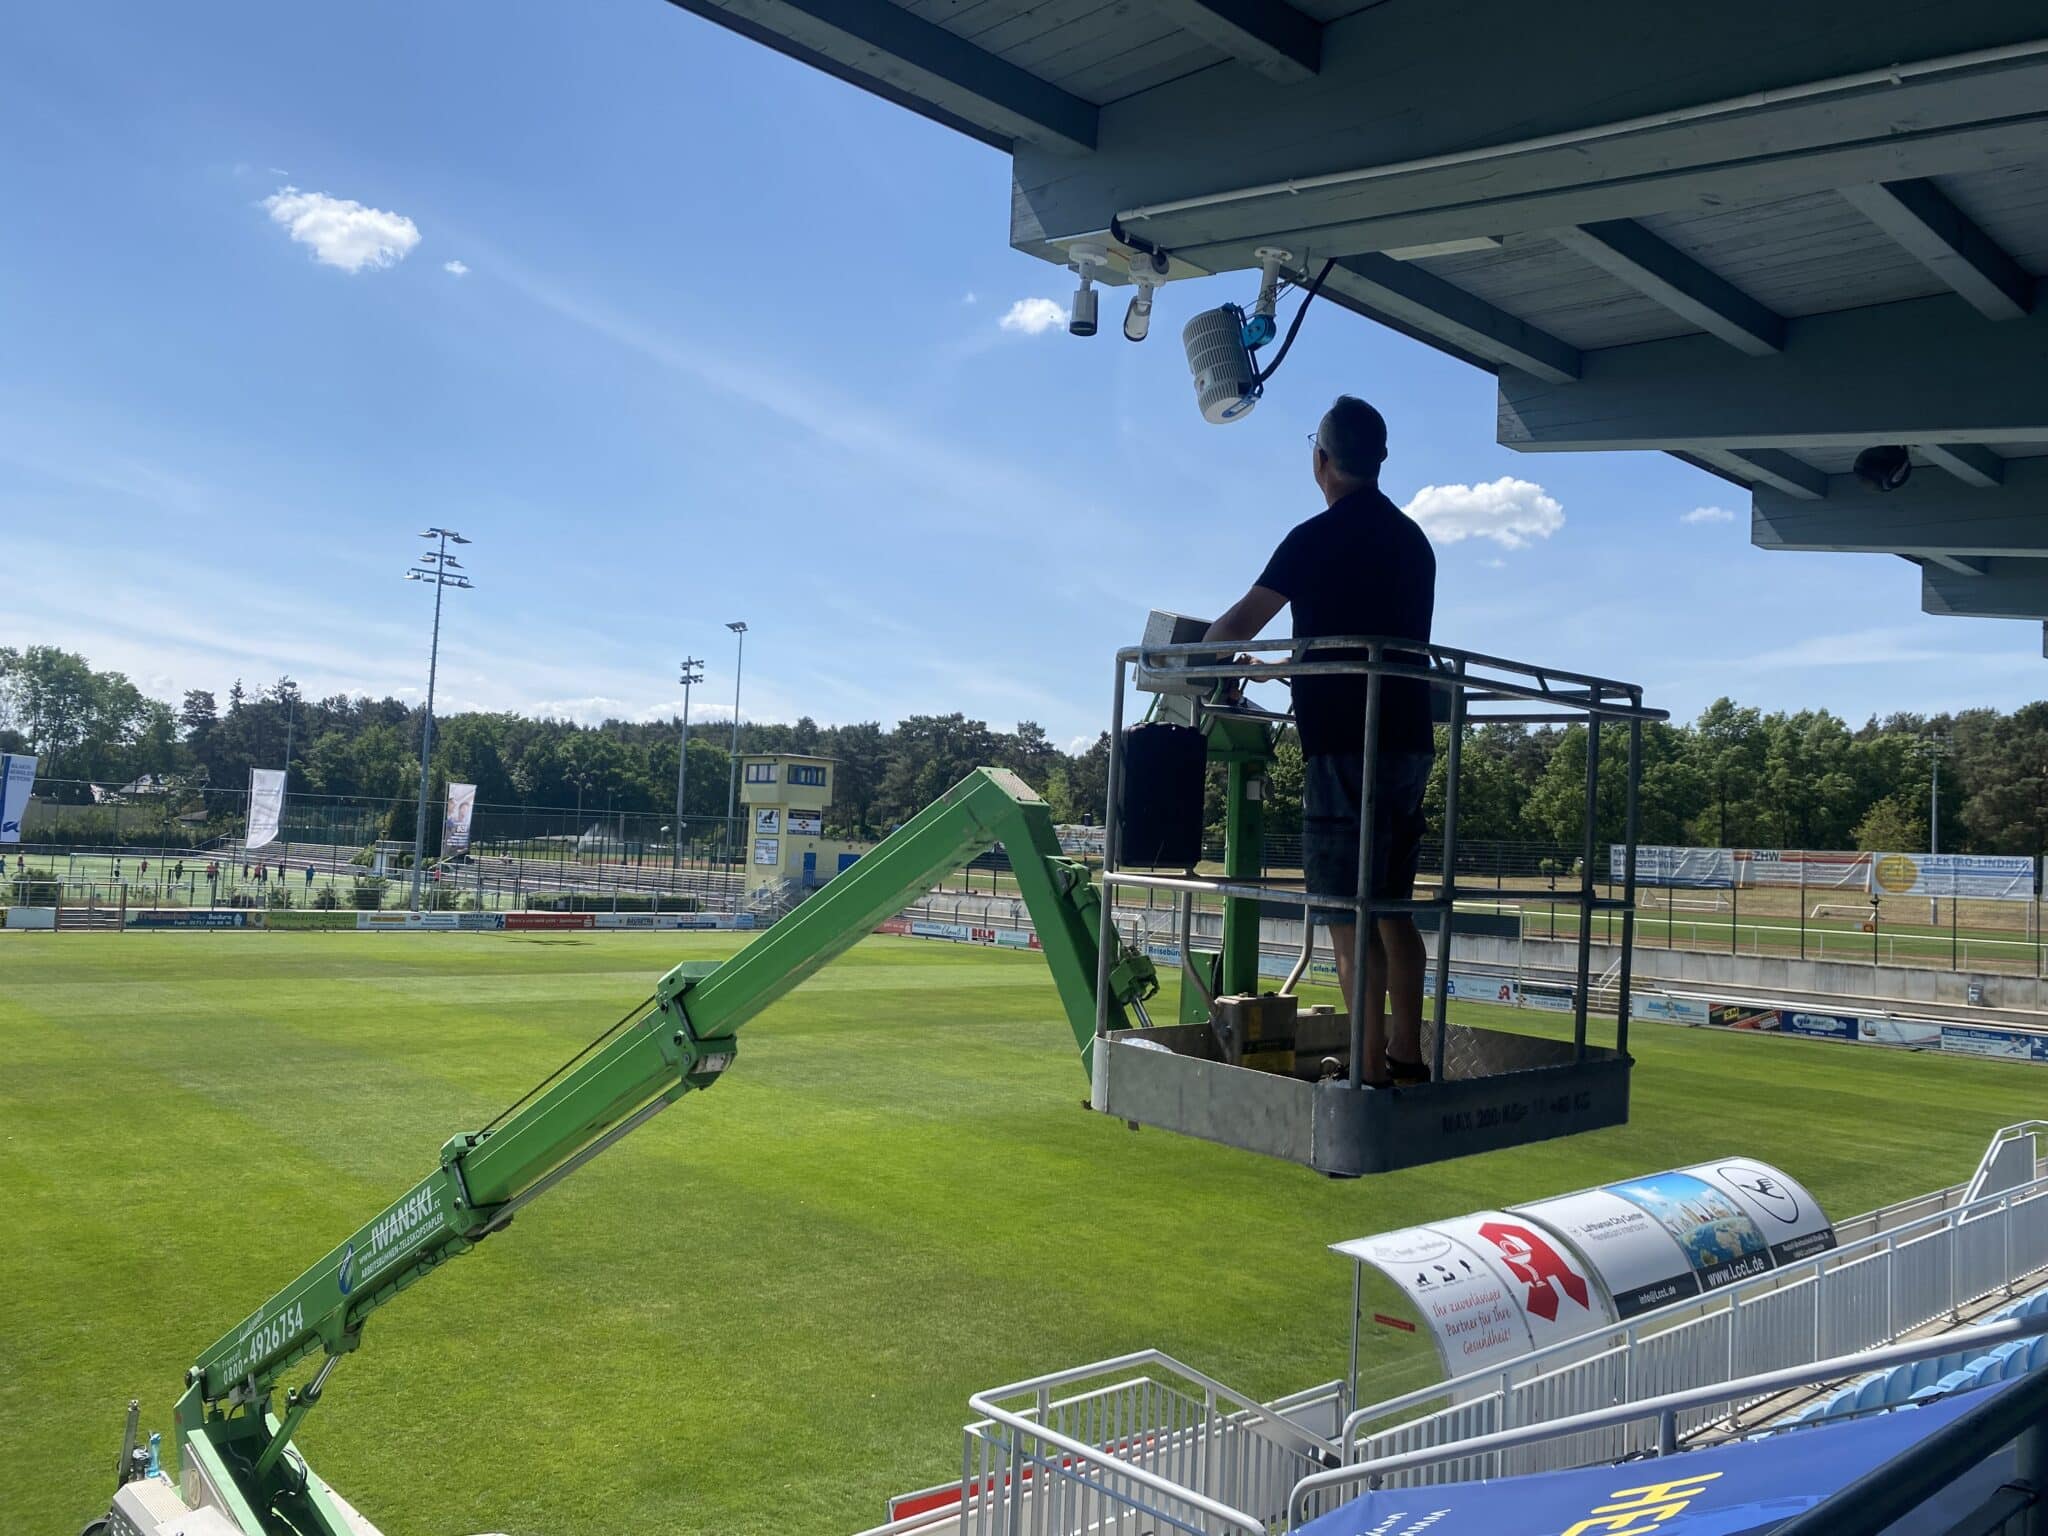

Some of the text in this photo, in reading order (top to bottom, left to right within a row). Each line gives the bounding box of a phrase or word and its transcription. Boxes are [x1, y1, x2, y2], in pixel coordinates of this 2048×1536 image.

[1753, 850, 1781, 862] ZHW
[1707, 1256, 1765, 1288] www.LccL.de
[1445, 1307, 1512, 1337] Partner für Ihre
[223, 1301, 304, 1385] 0800-4926754
[1463, 1327, 1511, 1355] Gesundheit!
[1560, 1471, 1724, 1536] HE
